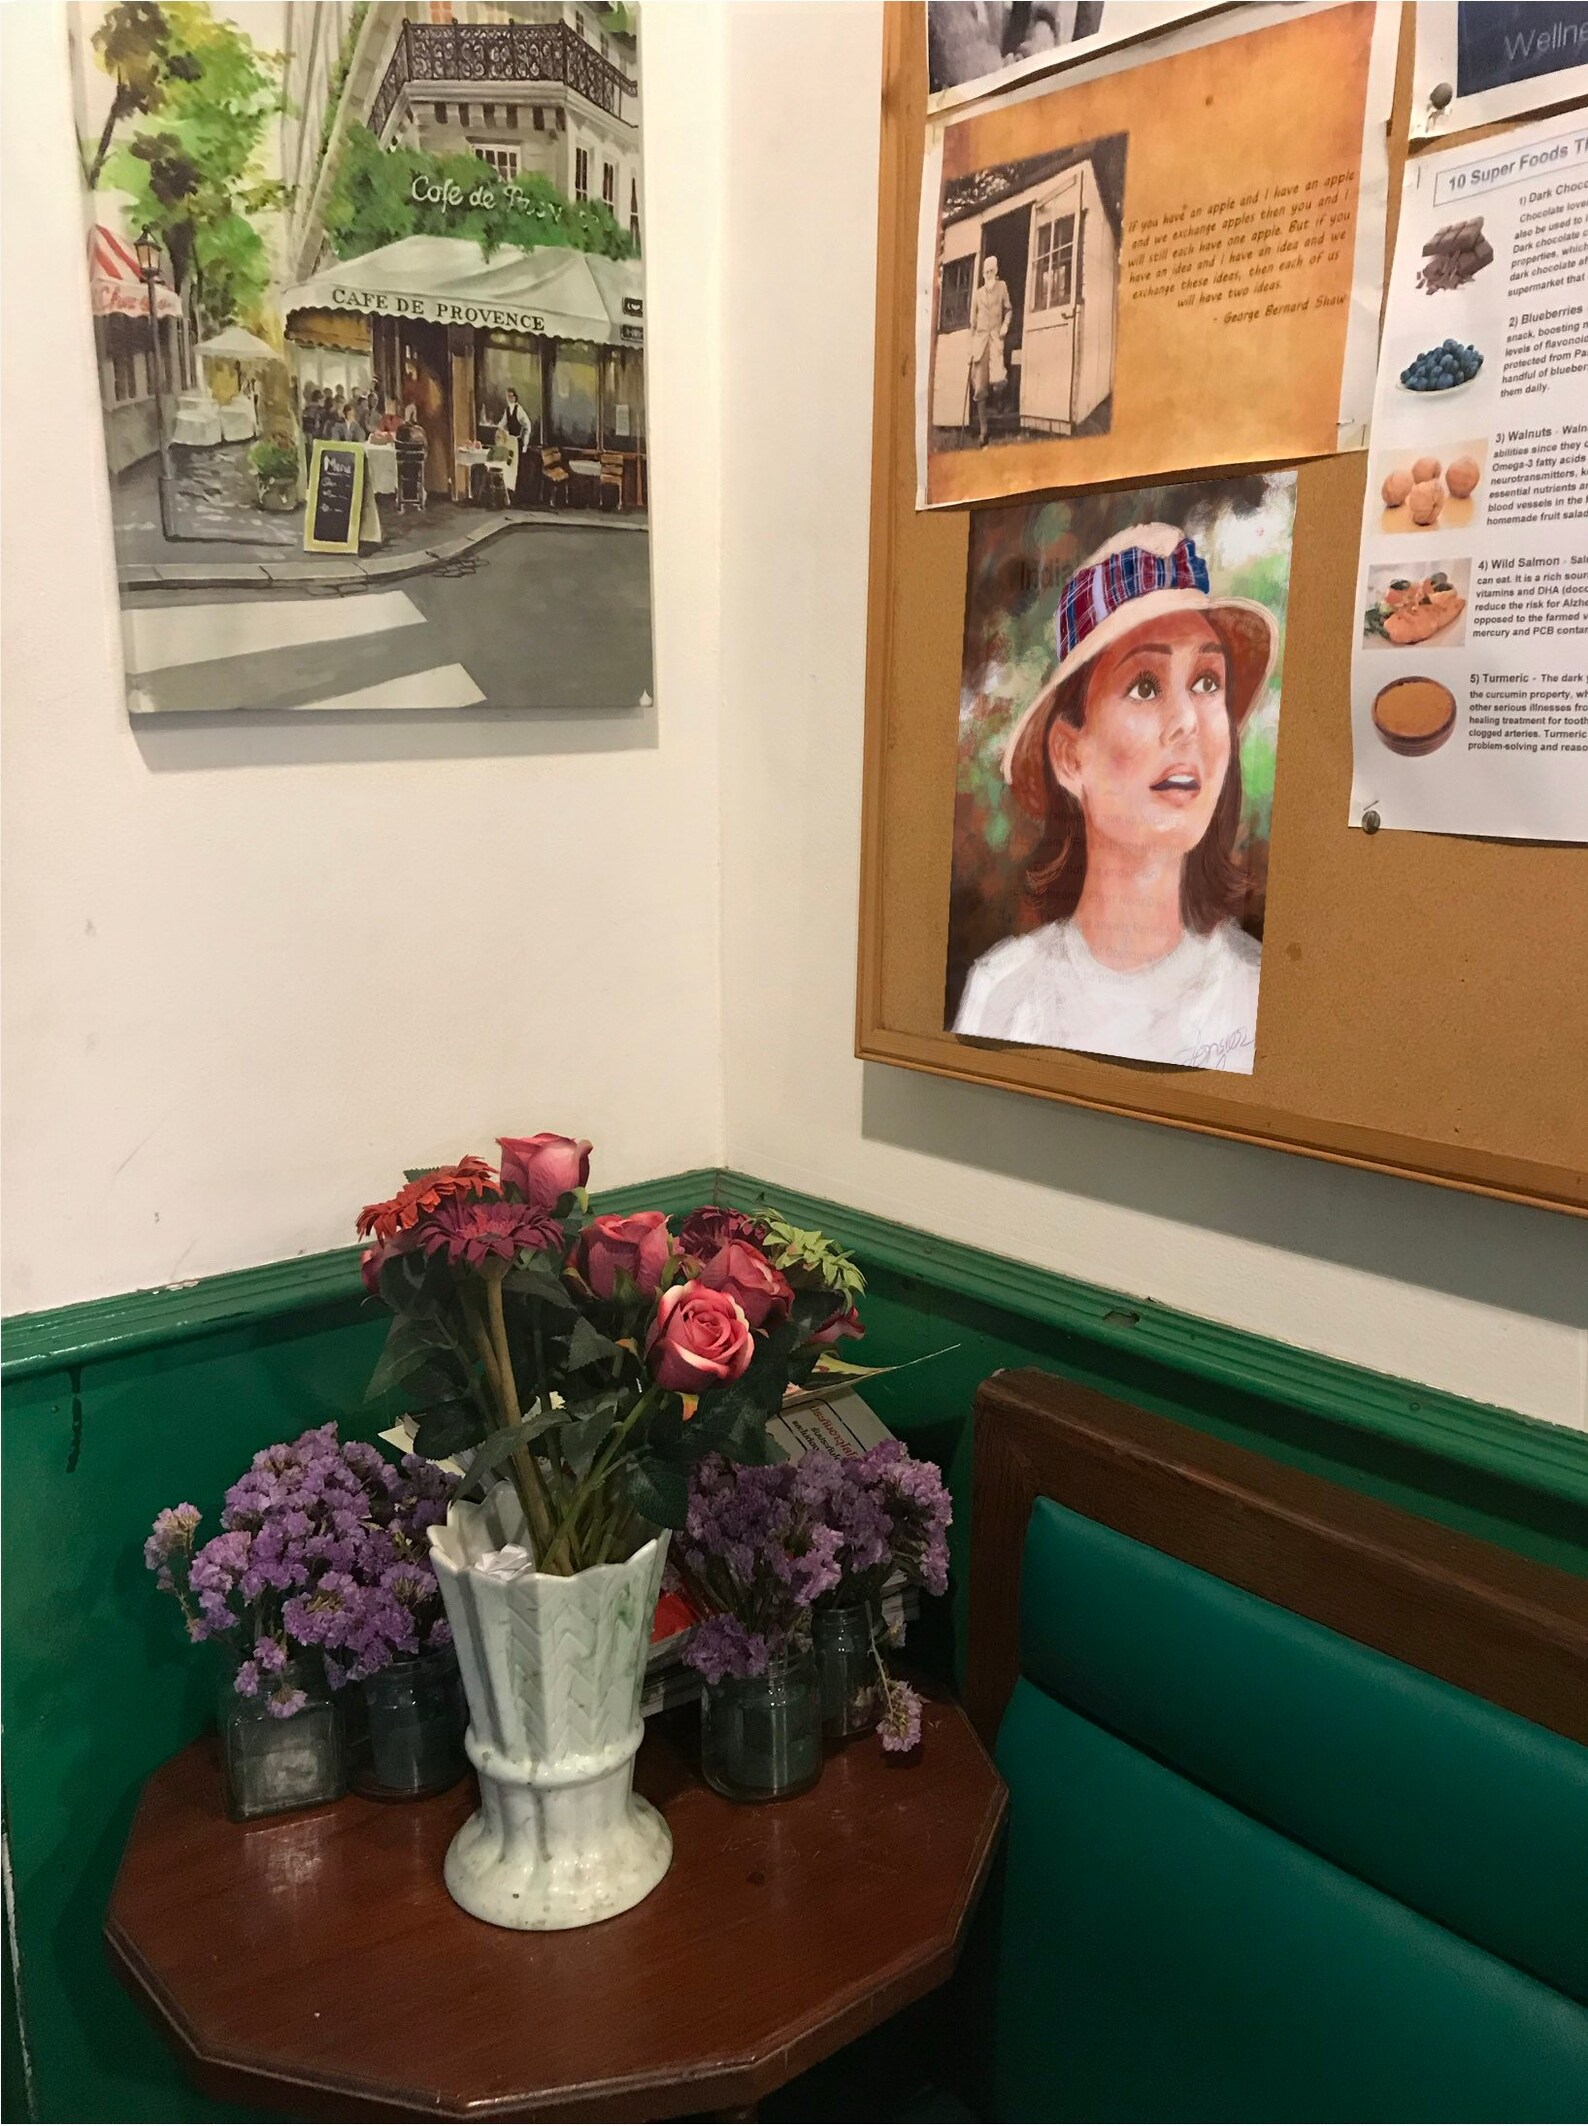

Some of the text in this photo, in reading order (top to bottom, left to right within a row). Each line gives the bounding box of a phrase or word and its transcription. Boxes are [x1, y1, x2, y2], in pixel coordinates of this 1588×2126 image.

[1449, 145, 1568, 191] 10 Super Foods
[469, 186, 496, 209] de
[1141, 219, 1158, 233] you
[1163, 211, 1185, 225] have
[1190, 207, 1202, 218] an
[1207, 197, 1235, 215] apple
[1240, 188, 1259, 206] and
[1274, 184, 1299, 199] have
[1305, 179, 1319, 191] an
[1324, 169, 1355, 188] apple
[1529, 188, 1552, 203] Dark
[1131, 235, 1150, 249] and
[1154, 234, 1168, 245] we
[1172, 223, 1216, 240] exchange
[1222, 212, 1255, 230] apples
[1260, 205, 1286, 220] then
[1291, 201, 1312, 216] you
[1318, 191, 1339, 207] and
[1520, 205, 1564, 223] Chocolate
[1514, 217, 1583, 240] also be used to
[1128, 253, 1145, 268] will
[1149, 248, 1168, 263] still
[1172, 243, 1195, 259] each
[1199, 240, 1222, 252] have
[1227, 234, 1246, 246] one
[1288, 219, 1309, 233] But
[1315, 213, 1327, 227] if
[1330, 211, 1351, 227] you
[1513, 231, 1580, 254] Dark chocolate
[1129, 272, 1151, 283] have
[1156, 268, 1168, 278] an
[1172, 262, 1192, 275] idea
[1197, 254, 1216, 270] and
[1229, 250, 1253, 264] have
[1258, 246, 1271, 257] an
[1277, 240, 1299, 253] idea
[1304, 231, 1325, 248] and
[1330, 230, 1346, 242] we
[1132, 284, 1175, 300] exchange
[1181, 277, 1208, 290] these
[1249, 263, 1274, 278] then
[1278, 254, 1303, 271] each
[1309, 250, 1324, 265] of
[1327, 250, 1340, 261] us
[1509, 260, 1576, 282] dark chocolate
[1508, 273, 1585, 297] supermarket that
[1177, 292, 1194, 308] will
[1199, 290, 1223, 303] have
[1227, 286, 1249, 298] two
[332, 288, 545, 331] CAFE DE PROVENCE
[1223, 293, 1347, 325] George Bernard Shaw
[1508, 305, 1583, 328] 2) Blueberries
[1538, 323, 1580, 337] boosting
[1505, 341, 1543, 357] levels of
[1503, 352, 1571, 372] protected from
[1501, 370, 1536, 383] handful
[1538, 367, 1548, 378] of
[1500, 387, 1523, 398] them
[1495, 433, 1505, 444] 3)
[1508, 427, 1552, 442] Walnuts
[1493, 441, 1581, 458] abilities since they
[1492, 454, 1586, 472] Omega-3 fatty acids
[1489, 483, 1577, 499] essential nutrients
[1488, 496, 1583, 512] blood vessels in the
[1486, 513, 1538, 525] homemade
[1540, 511, 1561, 521] fruit
[1478, 557, 1560, 572] 4) Wild Salmon
[1477, 577, 1494, 585] can
[1515, 574, 1522, 583] It
[1524, 574, 1532, 582] is
[1534, 574, 1541, 582] a
[1543, 571, 1562, 581] rich
[1476, 585, 1559, 598] vitamins and DHA
[1475, 602, 1506, 611] reduce
[1508, 600, 1523, 610] the
[1525, 600, 1544, 609] risk
[1546, 599, 1560, 608] for
[1473, 612, 1580, 626] opposed to the farmed
[1472, 626, 1554, 638] mercury and PCB
[1470, 673, 1583, 685] 5) Turmeric The dark
[1469, 690, 1483, 699] the
[1485, 690, 1527, 699] curcumin
[1469, 703, 1492, 712] other
[1493, 703, 1527, 712] serious
[1529, 703, 1572, 712] illnesses
[1469, 716, 1500, 726] healing
[1502, 717, 1546, 725] treatment
[1548, 716, 1562, 725] for
[1468, 729, 1502, 739] clogged
[1544, 729, 1587, 738] Turmeric
[1468, 742, 1538, 753] problem-solving
[1540, 743, 1558, 751] and
